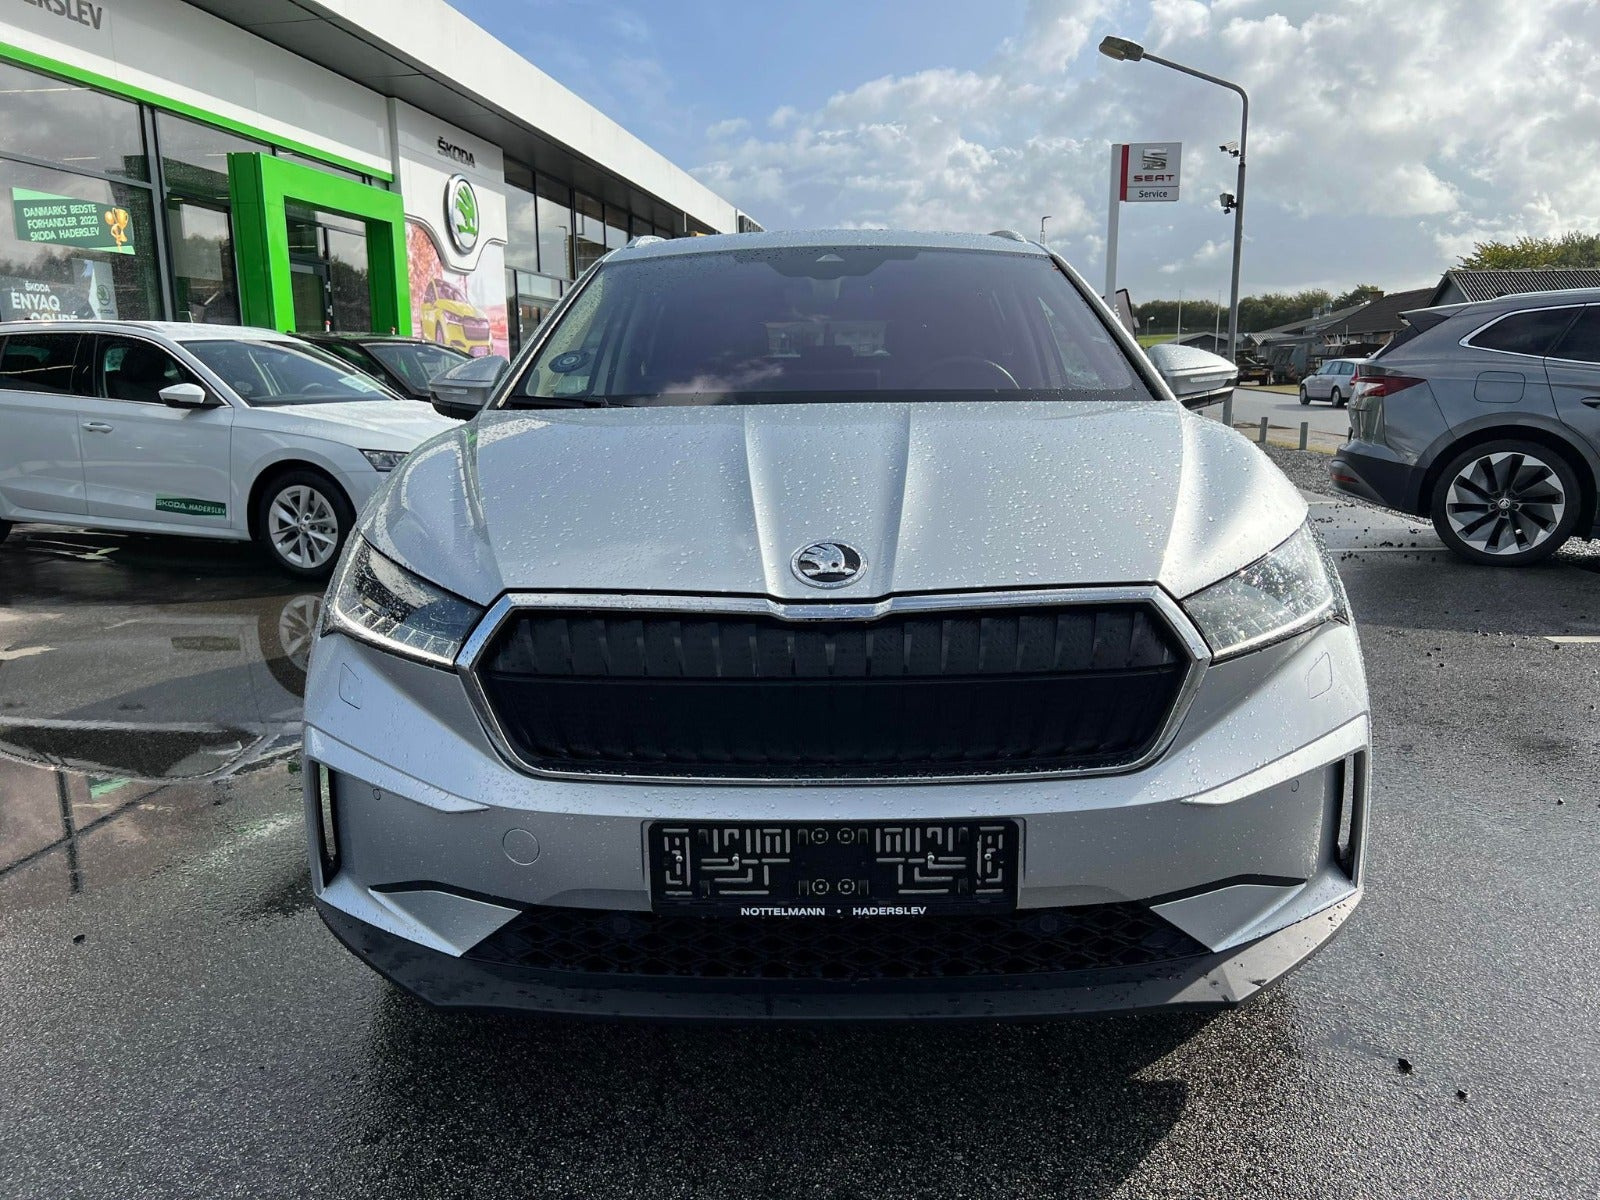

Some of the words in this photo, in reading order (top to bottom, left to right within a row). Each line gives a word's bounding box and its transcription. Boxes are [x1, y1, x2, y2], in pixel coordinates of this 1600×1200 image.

[437, 135, 476, 168] ŠKODA
[1133, 174, 1175, 182] SEAT
[1138, 190, 1168, 198] Service
[23, 205, 67, 217] DANMARKS
[69, 204, 97, 214] BEDSTE
[27, 216, 77, 229] FORHANDLER
[58, 227, 99, 238] HADERSLEV
[11, 291, 61, 311] ENYAQ
[188, 503, 226, 514] HADERSLEV
[740, 907, 826, 916] NOTTELMANN
[852, 906, 927, 916] HADERSLEV
